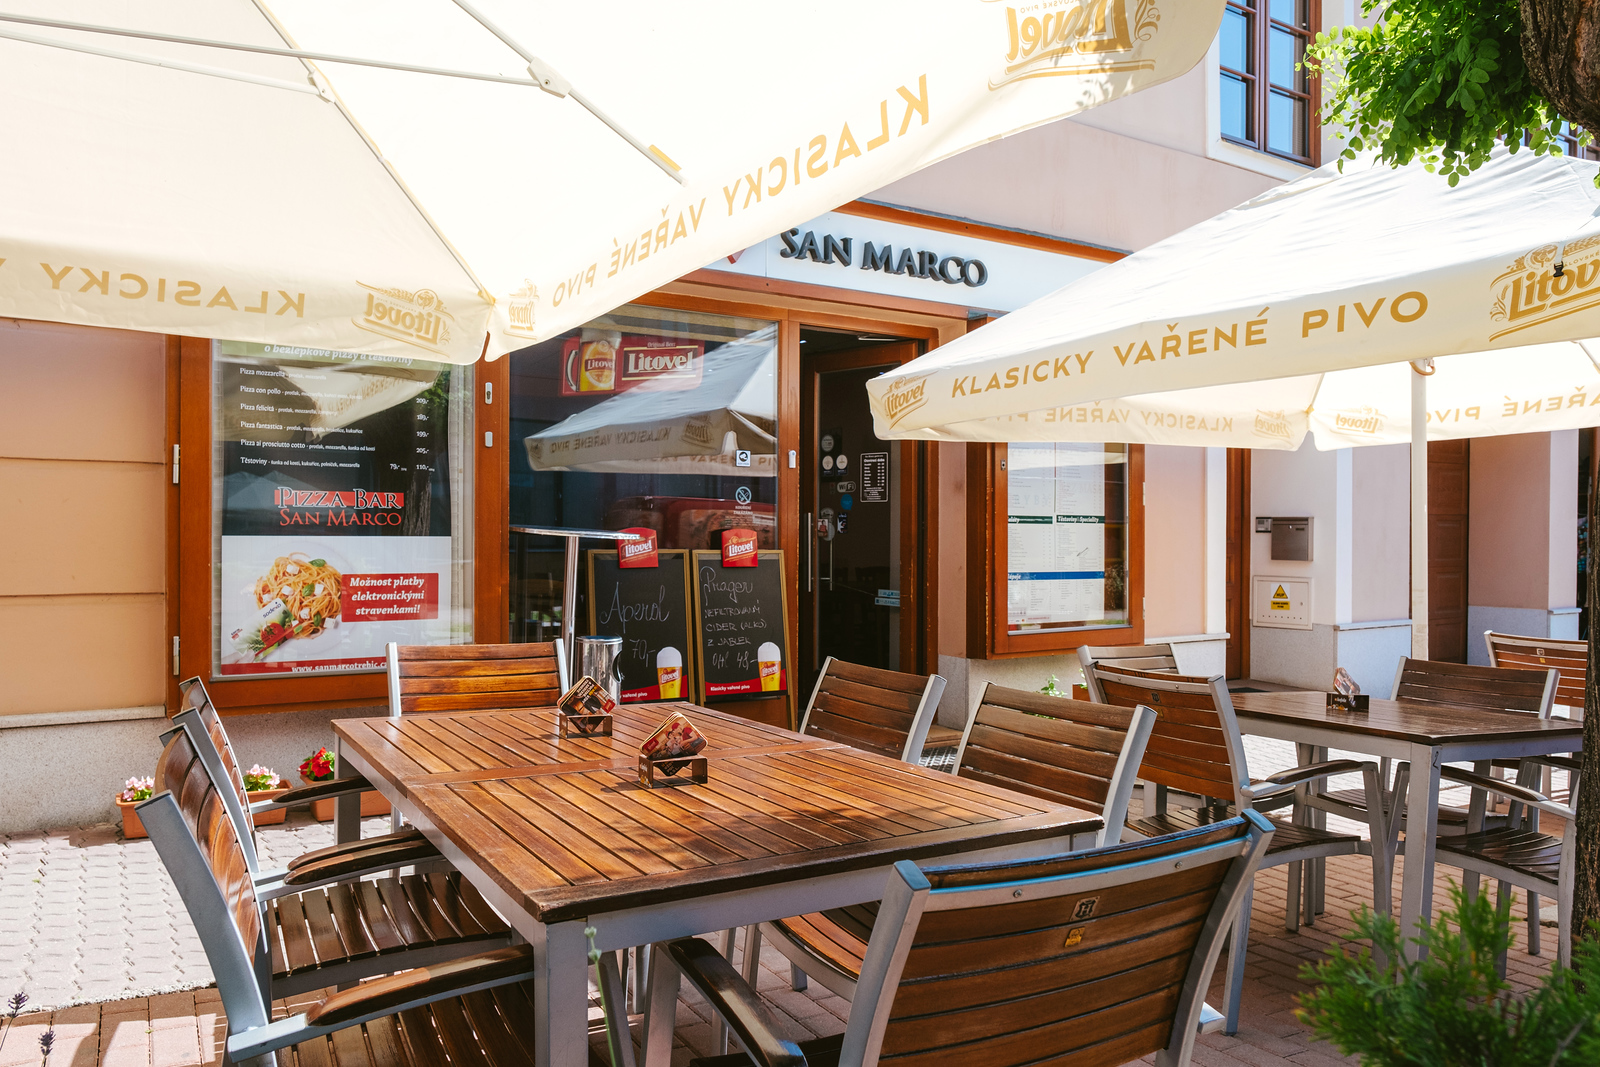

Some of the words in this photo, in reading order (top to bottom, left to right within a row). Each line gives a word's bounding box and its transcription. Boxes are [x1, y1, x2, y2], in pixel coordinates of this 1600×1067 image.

[780, 228, 853, 267] SAN
[860, 241, 988, 287] MARCO
[1507, 258, 1600, 322] Litov
[951, 350, 1094, 399] KLASICKY
[1113, 306, 1270, 367] VAŘENÉ
[1301, 290, 1429, 339] PIVO
[627, 350, 694, 374] Litovel
[240, 367, 255, 375] Pizza
[255, 368, 286, 377] mozzarella
[267, 387, 281, 395] pollo
[886, 378, 927, 420] Litovel
[240, 420, 255, 428] Pizza
[255, 421, 283, 430] fantastica
[240, 438, 255, 446] Pizza
[240, 456, 268, 466] Těstoviny
[278, 486, 347, 509] PIZZA
[353, 488, 402, 510] BAR
[279, 508, 320, 526] SAN
[326, 509, 402, 527] MARCO
[625, 539, 653, 558] Litovel
[728, 540, 754, 557] Litovel
[349, 577, 392, 587] Možnost
[393, 576, 425, 589] platby
[699, 565, 754, 607] Prager
[351, 590, 425, 602] elektronickými
[355, 604, 421, 616] stravenkami!
[600, 581, 671, 634] Aperol
[705, 621, 738, 634] CIDER
[717, 635, 752, 647] JABLEK
